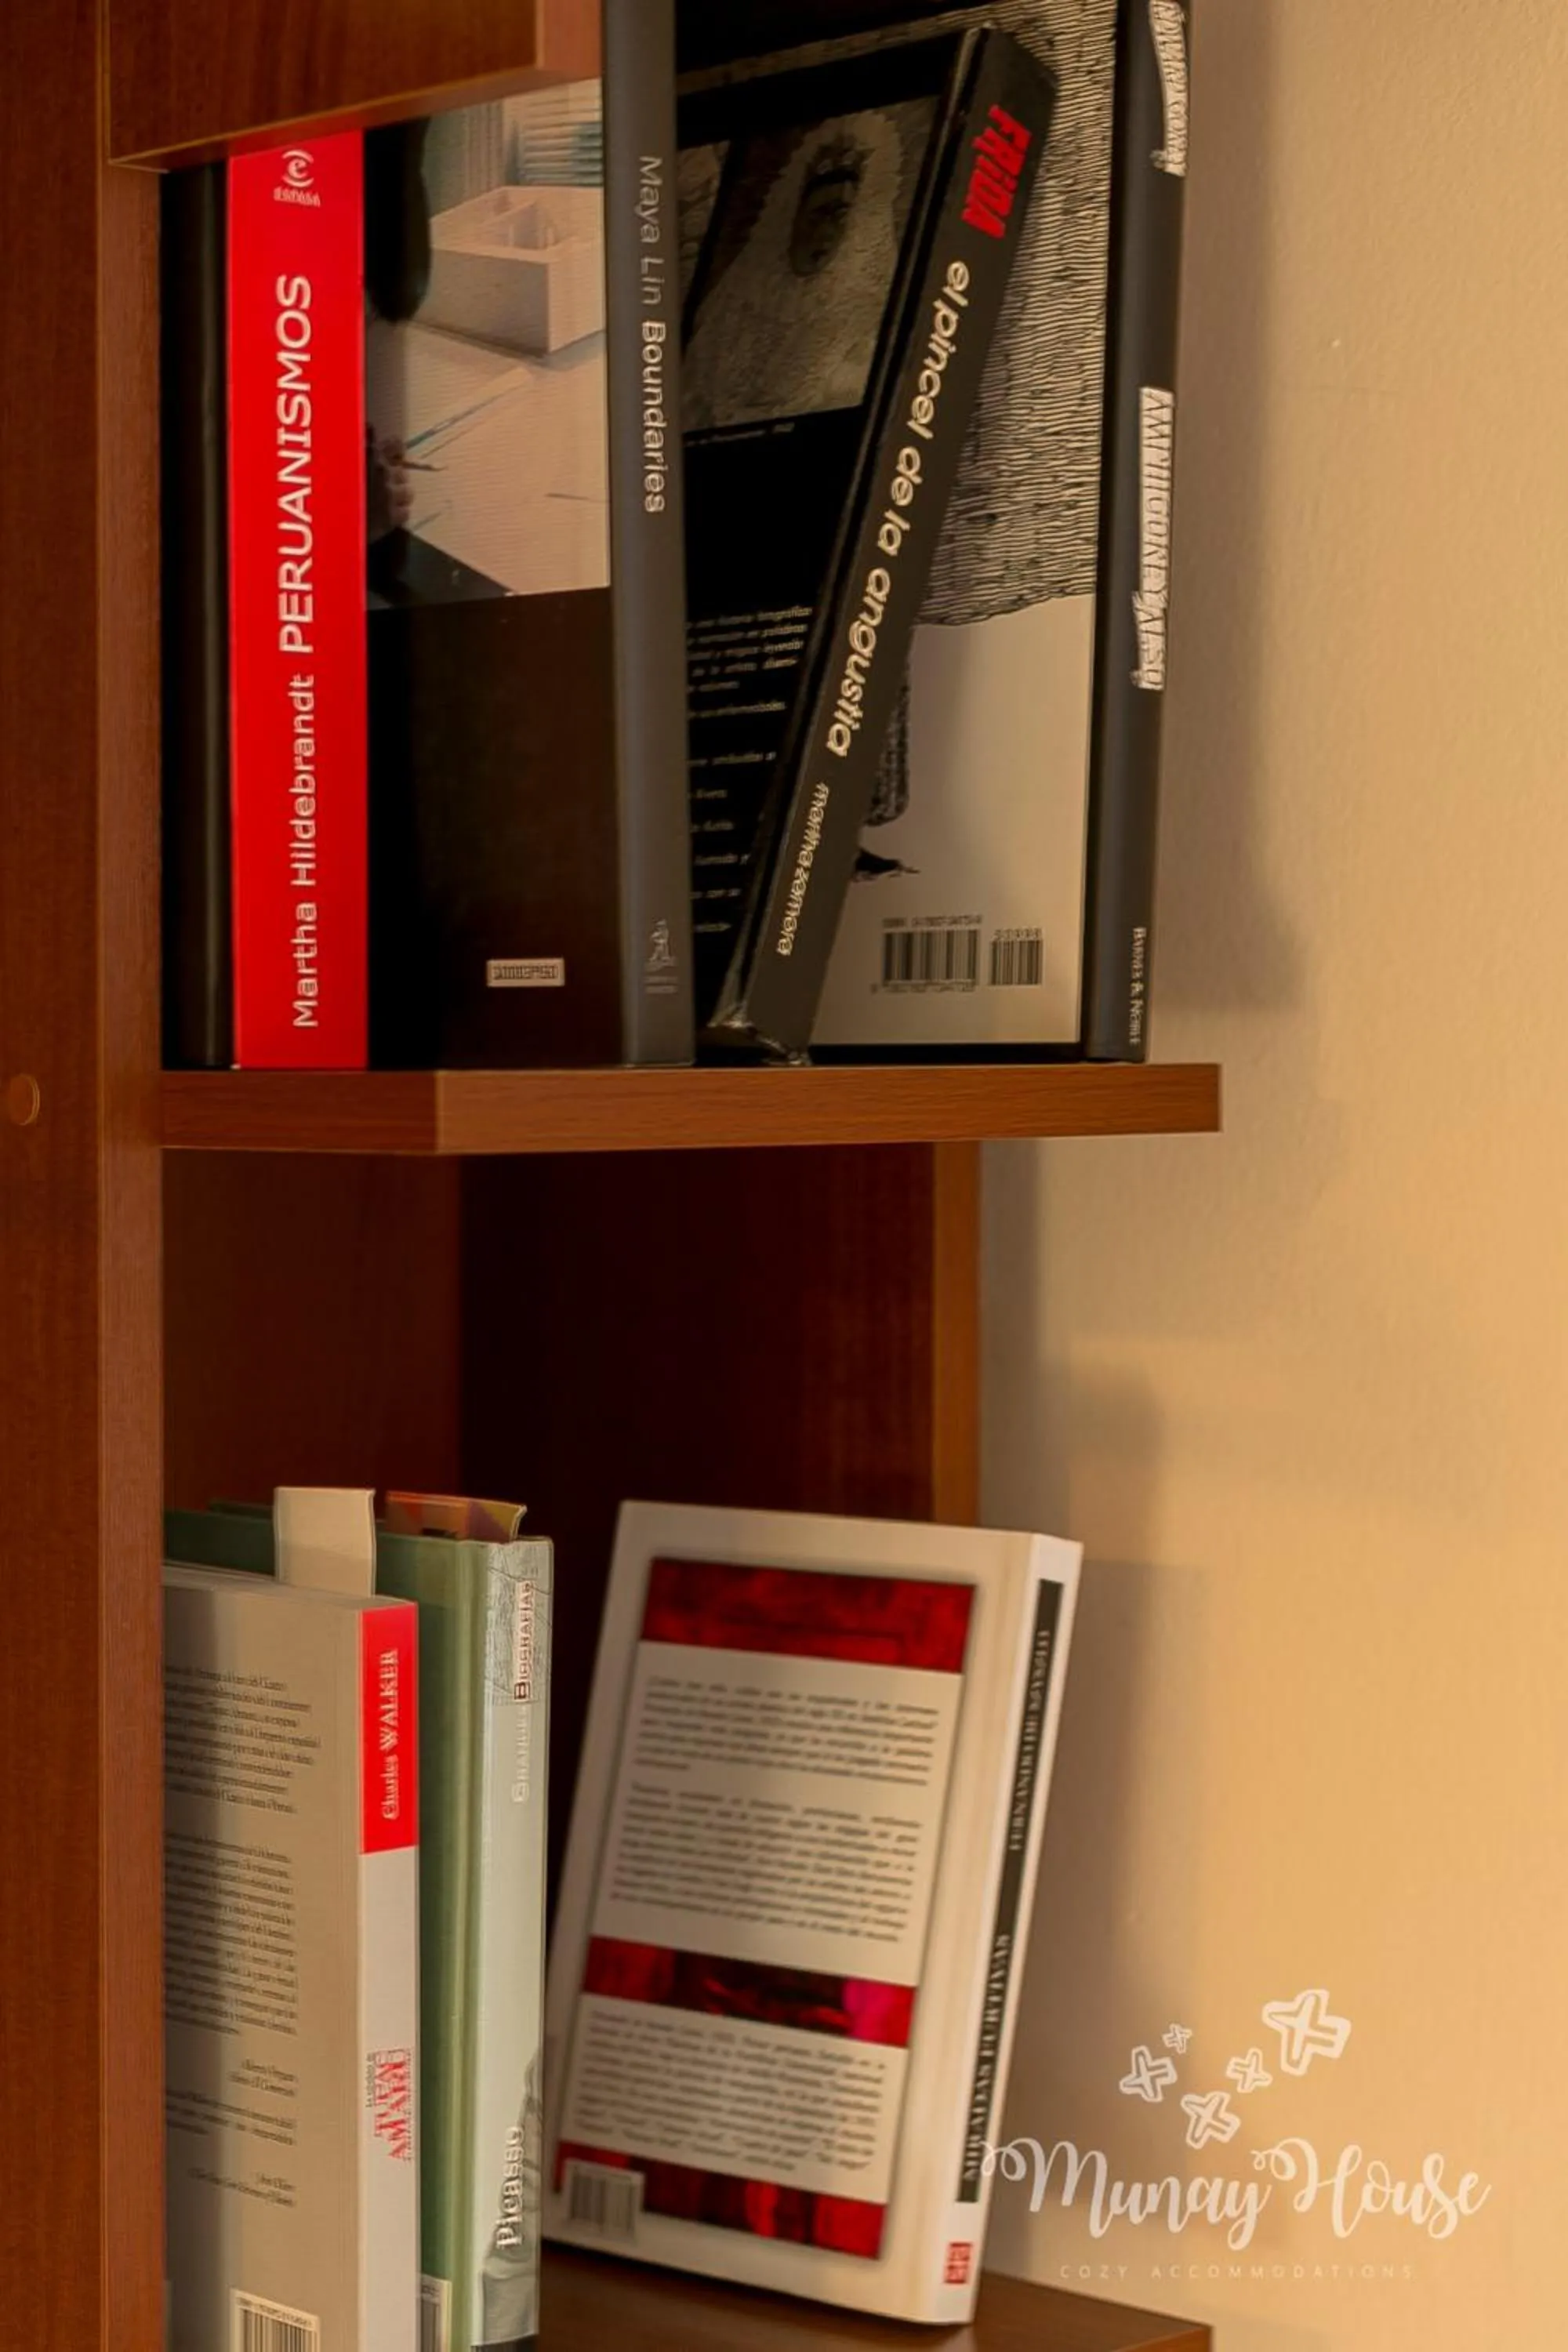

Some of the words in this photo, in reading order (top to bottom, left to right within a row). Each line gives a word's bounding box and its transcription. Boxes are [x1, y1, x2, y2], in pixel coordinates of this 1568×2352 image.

[637, 156, 663, 243] Maya
[640, 256, 663, 306] Lin
[946, 260, 970, 307] el
[641, 320, 666, 514] Boundaries
[906, 299, 960, 439] pincel
[275, 274, 314, 653] PERUANISMOS
[891, 446, 923, 506] de
[877, 510, 911, 556] la
[826, 567, 891, 757] angustia
[288, 673, 317, 887] Hildebrandt
[290, 902, 318, 1028] Martha
[379, 1647, 399, 1752] WALKER
[381, 1754, 401, 1820] Charles
[495, 2126, 524, 2250] Picasso
